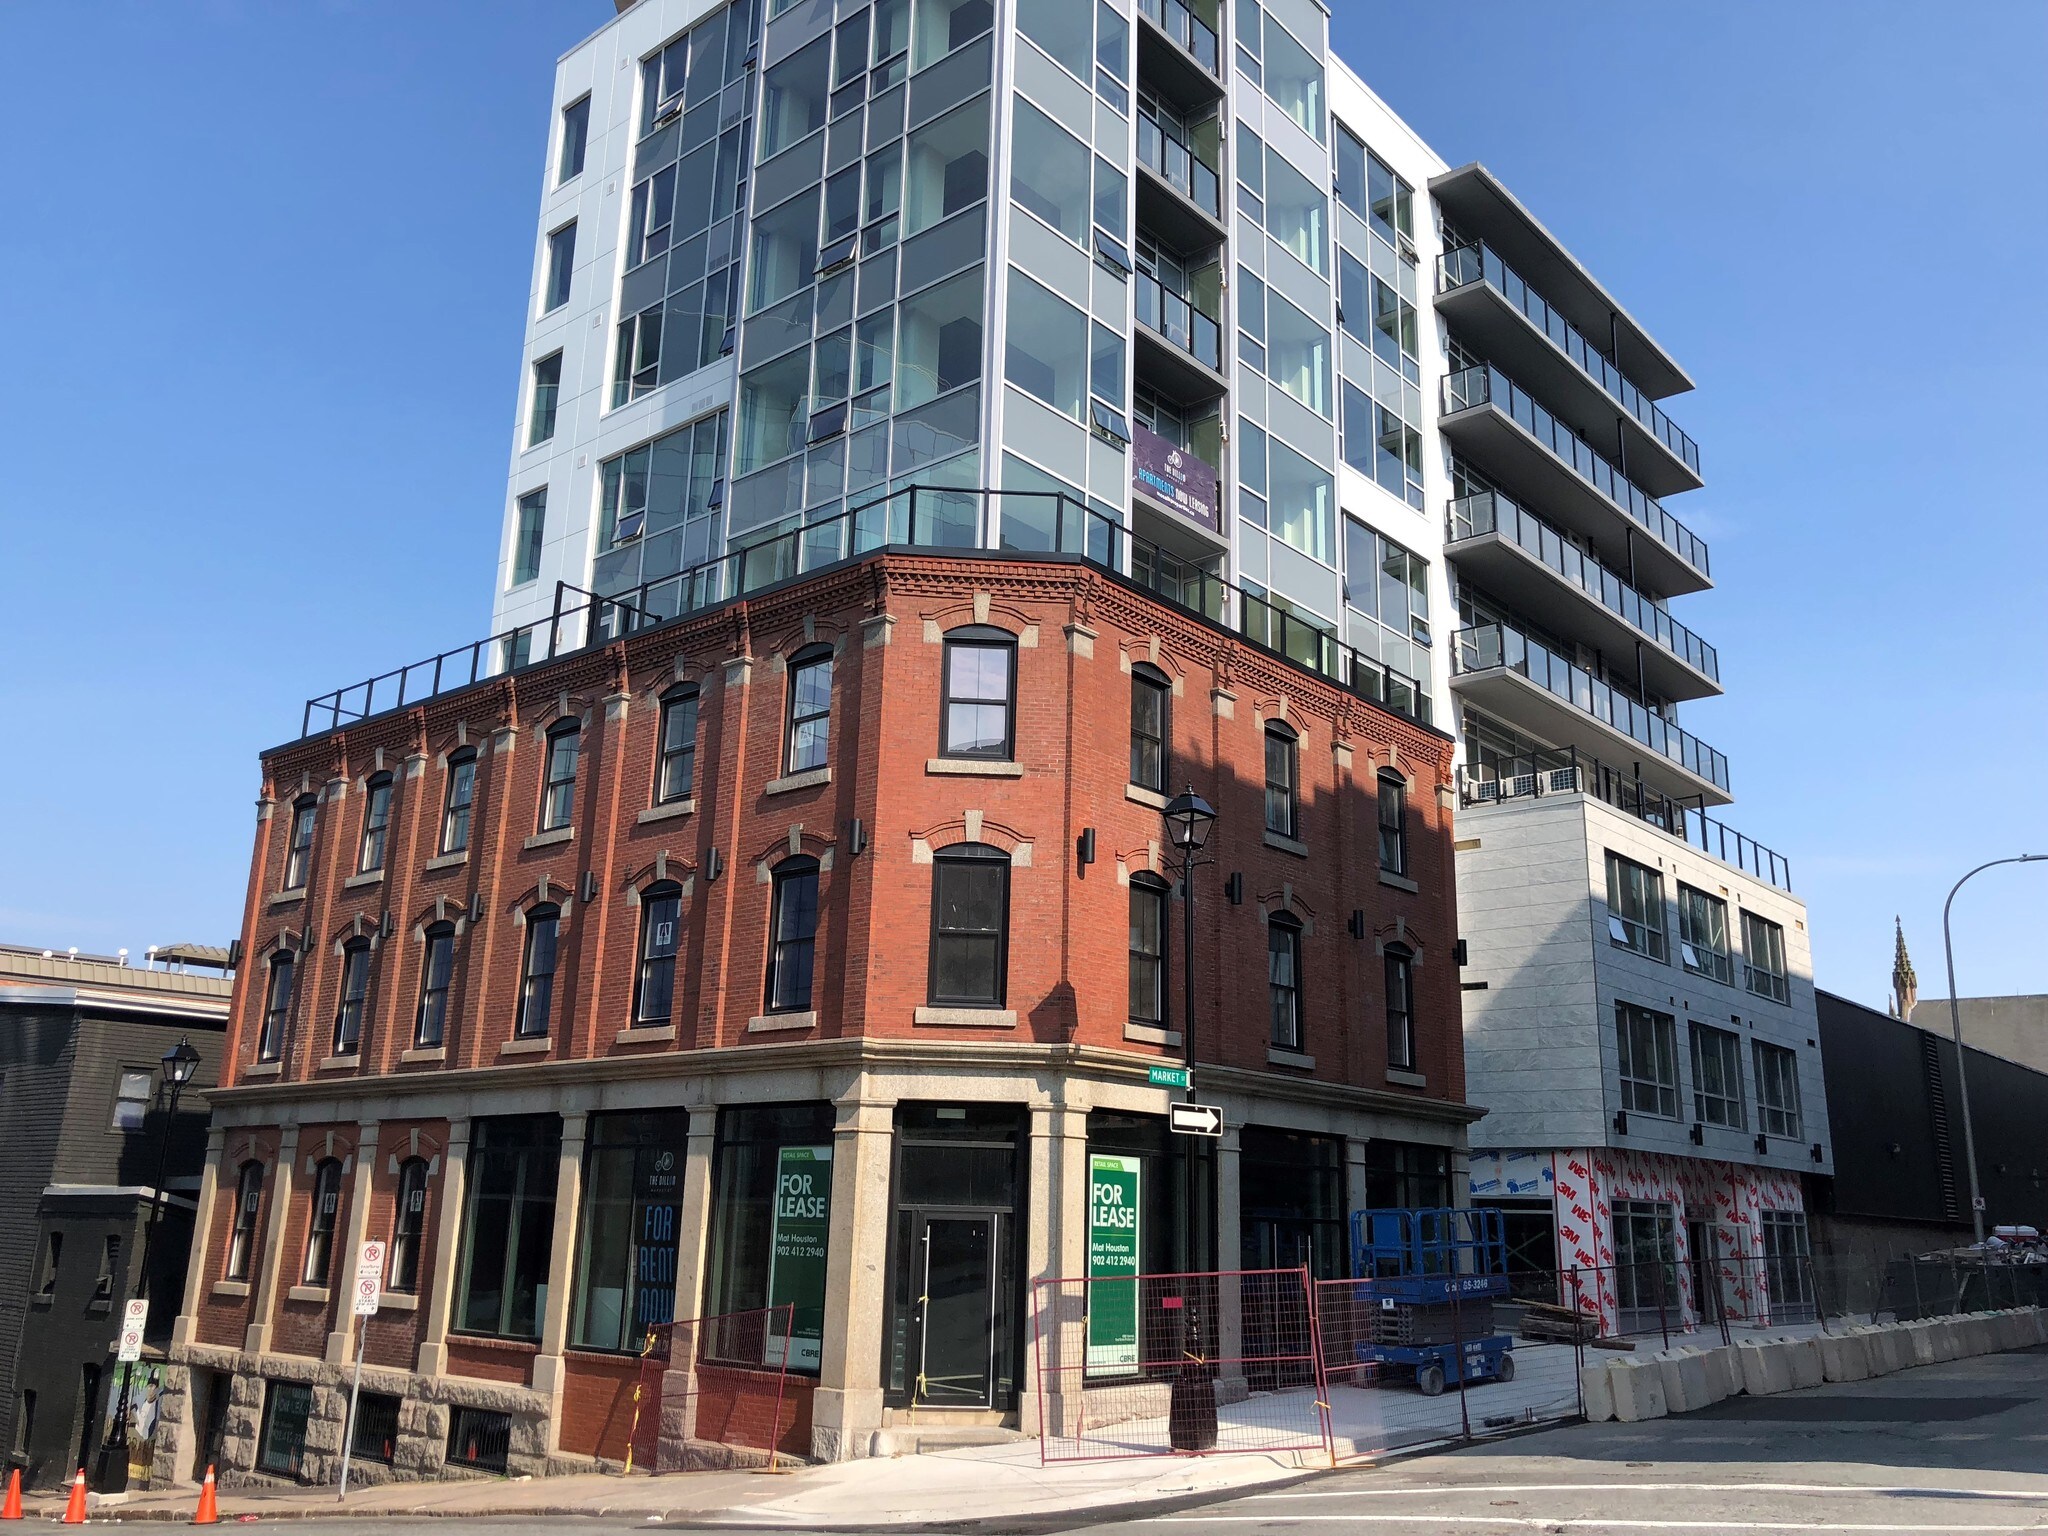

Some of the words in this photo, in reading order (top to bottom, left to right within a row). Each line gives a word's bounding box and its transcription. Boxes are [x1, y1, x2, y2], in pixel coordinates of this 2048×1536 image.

[1138, 467, 1175, 497] APARTMENTS
[1152, 1069, 1180, 1083] MARKET
[1107, 1161, 1119, 1169] SPACE
[780, 1174, 813, 1195] FOR
[1093, 1183, 1123, 1205] FOR
[1557, 1182, 1577, 1201] 3M
[779, 1196, 826, 1218] LEASE
[1093, 1205, 1134, 1228] LEASE
[644, 1205, 673, 1241] FOR
[777, 1233, 790, 1242] Mat
[791, 1233, 818, 1243] Houston
[1560, 1226, 1580, 1245] 3M
[776, 1246, 790, 1256] 902
[791, 1246, 805, 1257] 412
[806, 1247, 825, 1257] 2940
[1092, 1242, 1104, 1252] Mat
[1105, 1242, 1129, 1253] Houston
[640, 1246, 675, 1283] RENT
[1092, 1255, 1105, 1265] 902
[1106, 1255, 1119, 1266] 412
[1119, 1255, 1136, 1266] 2940
[639, 1287, 674, 1323] NOW
[801, 1348, 820, 1358] CBRE
[1119, 1354, 1136, 1363] CBRE
